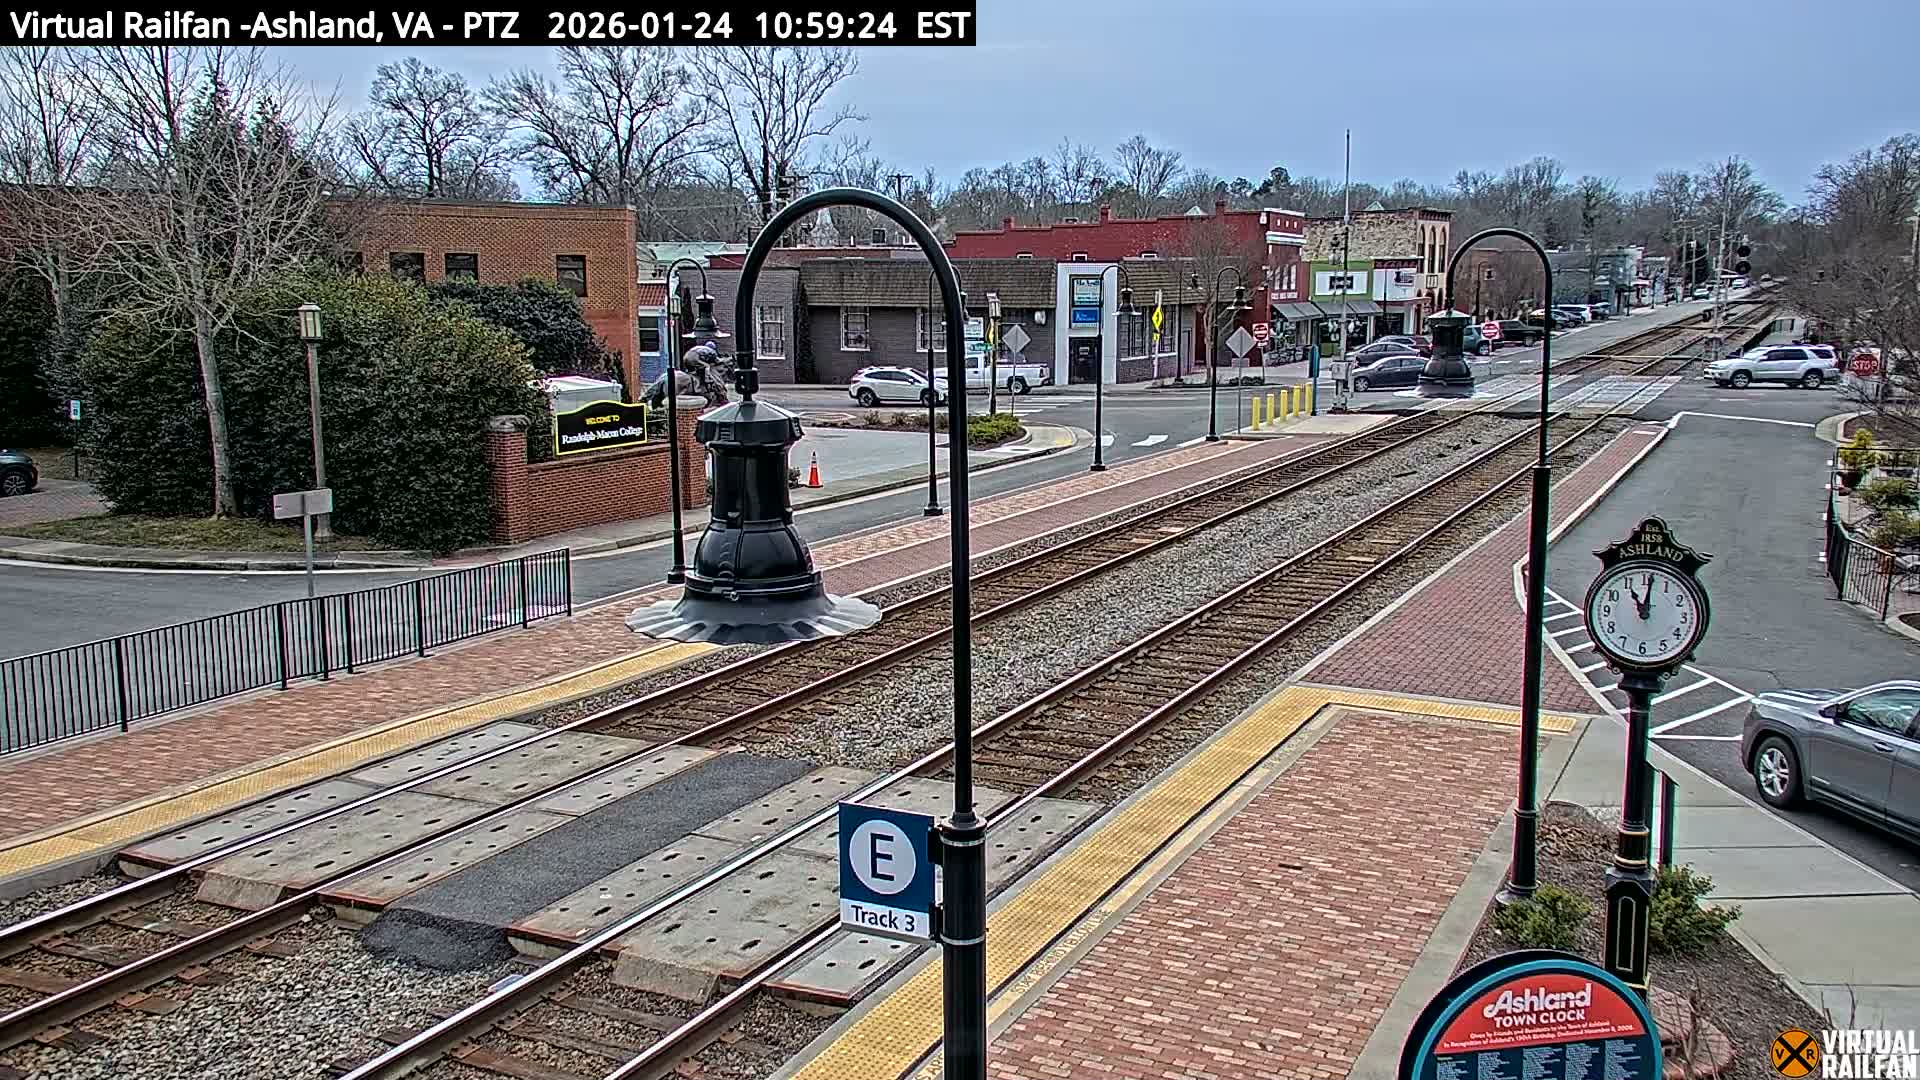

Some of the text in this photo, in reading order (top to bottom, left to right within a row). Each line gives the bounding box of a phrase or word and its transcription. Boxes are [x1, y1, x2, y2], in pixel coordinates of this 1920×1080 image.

[1854, 359, 1878, 370] STOP
[619, 426, 643, 437] College
[1641, 533, 1663, 543] 1858
[1619, 543, 1684, 562] ASHLAND
[1664, 580, 1669, 593] 1
[1606, 589, 1620, 602] 10
[1676, 594, 1684, 607] 2
[1603, 604, 1611, 617] 9
[1680, 612, 1688, 624] 3
[1607, 621, 1616, 634] 8
[1673, 627, 1682, 640] 4
[1618, 636, 1627, 648] 7
[1638, 641, 1647, 654] 6
[1659, 640, 1668, 652] 5
[870, 832, 895, 881] E
[851, 904, 915, 932] Track 3
[1484, 983, 1592, 1018] Ashland
[1494, 1009, 1585, 1028] TOWN CLOCK
